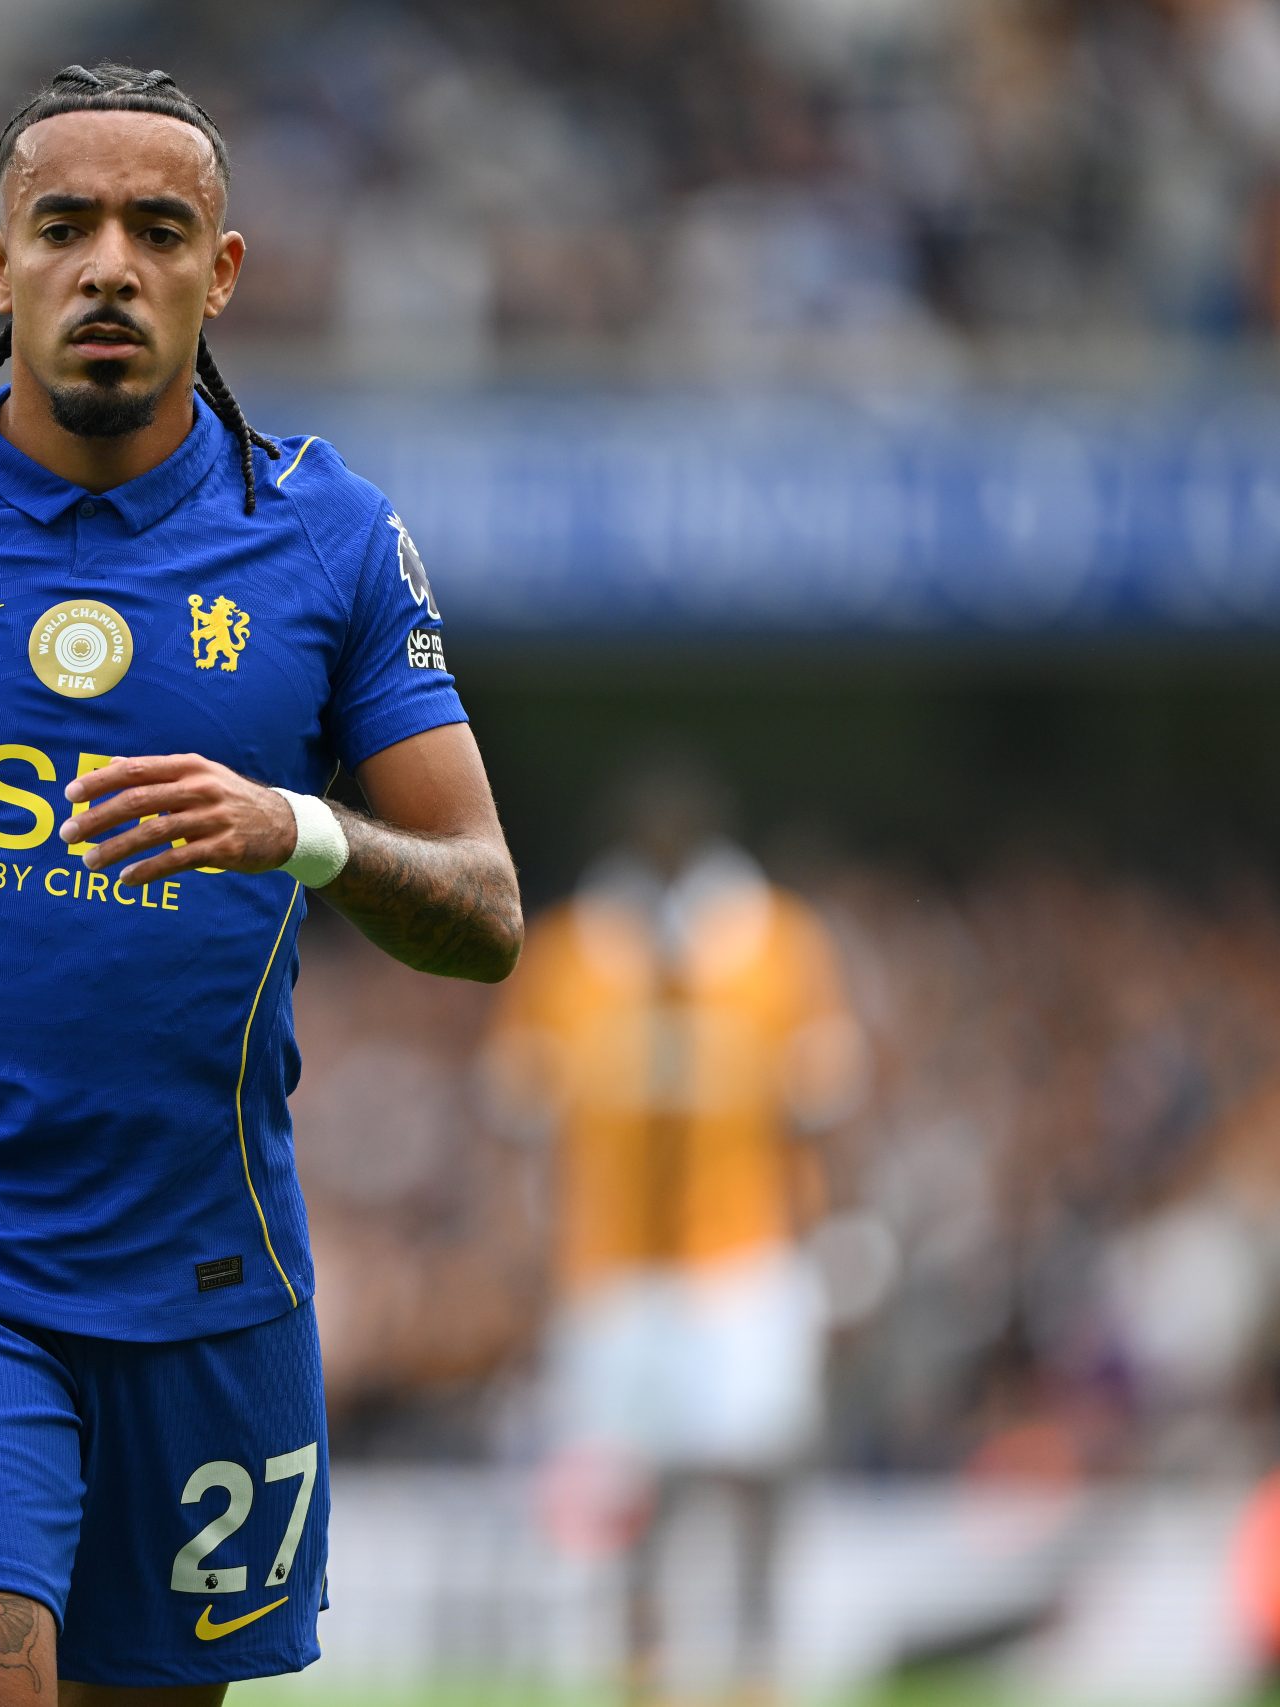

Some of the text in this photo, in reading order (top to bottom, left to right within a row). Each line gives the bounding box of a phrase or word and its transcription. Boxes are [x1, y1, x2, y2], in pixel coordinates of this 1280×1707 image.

[39, 607, 124, 664] WORLD CHAMPIONS
[407, 629, 430, 650] No
[57, 673, 95, 690] FIFA
[44, 867, 181, 911] CIRCLE
[170, 1441, 318, 1594] 27
